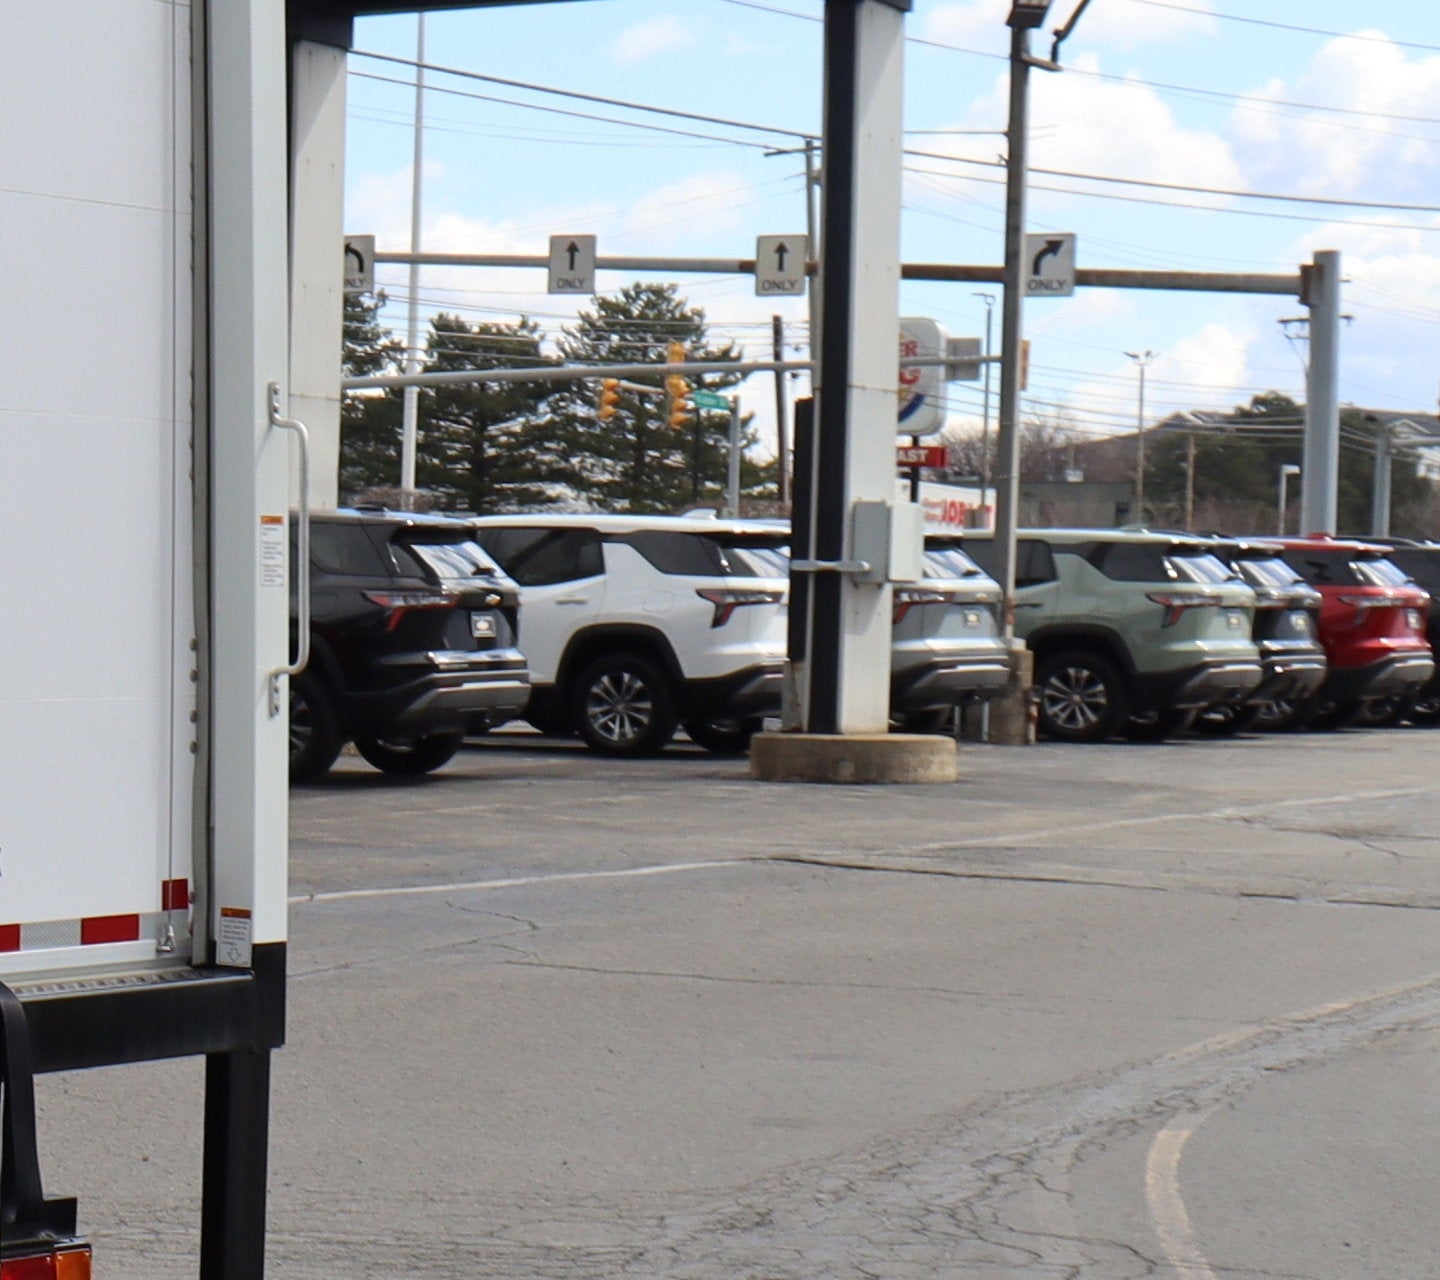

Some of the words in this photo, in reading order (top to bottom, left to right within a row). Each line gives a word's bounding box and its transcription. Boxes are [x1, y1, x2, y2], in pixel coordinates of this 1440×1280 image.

[344, 277, 365, 289] NLY
[556, 277, 587, 289] ONLY
[761, 279, 797, 291] ONLY
[1028, 278, 1067, 291] ONLY
